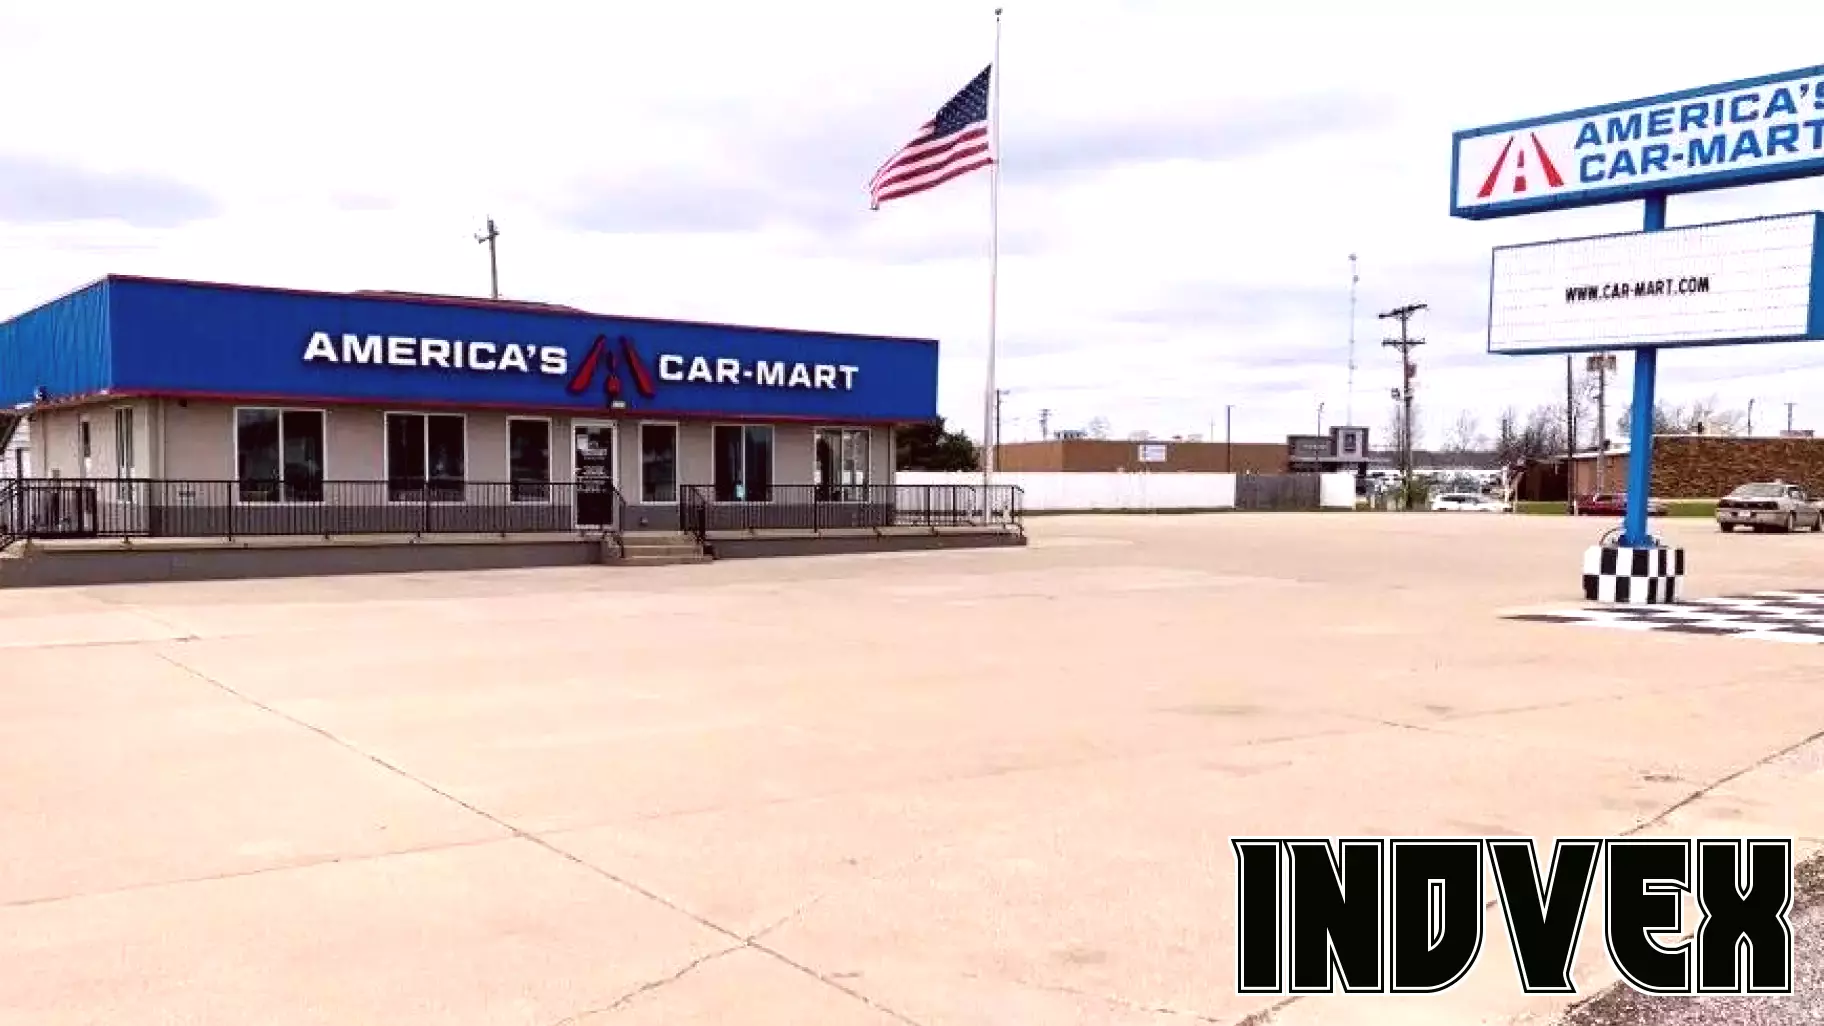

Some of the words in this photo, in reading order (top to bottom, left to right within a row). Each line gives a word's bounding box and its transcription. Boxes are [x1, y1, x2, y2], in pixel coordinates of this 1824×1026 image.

[1580, 119, 1824, 183] CAR-MART
[1565, 276, 1710, 304] WWW.CAR-MART.COM
[303, 331, 568, 375] AMERICA'S
[658, 353, 860, 390] CAR-MART
